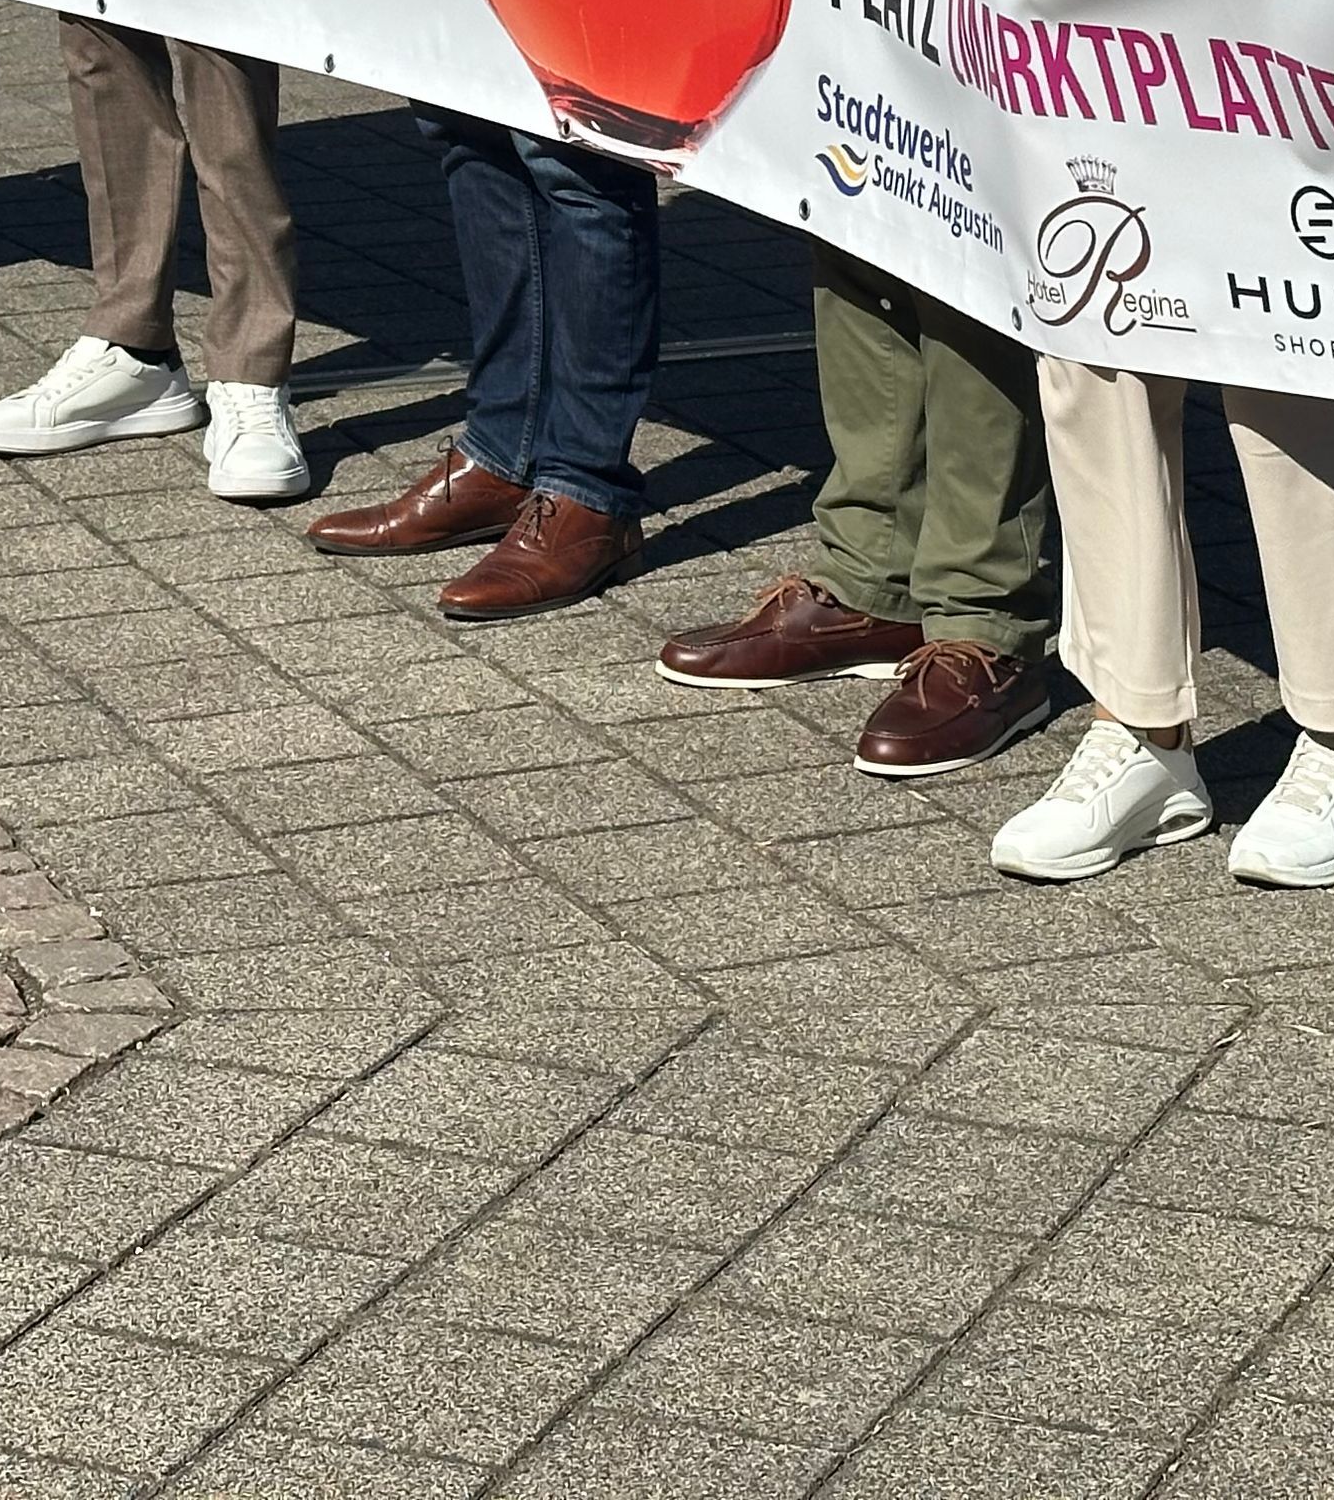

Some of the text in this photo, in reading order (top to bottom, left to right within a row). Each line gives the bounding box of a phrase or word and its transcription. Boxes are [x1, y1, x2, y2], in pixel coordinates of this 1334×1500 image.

[816, 73, 975, 192] Stadtwerke
[872, 154, 1005, 254] Sankt Augustin
[1026, 269, 1067, 305] Hotel
